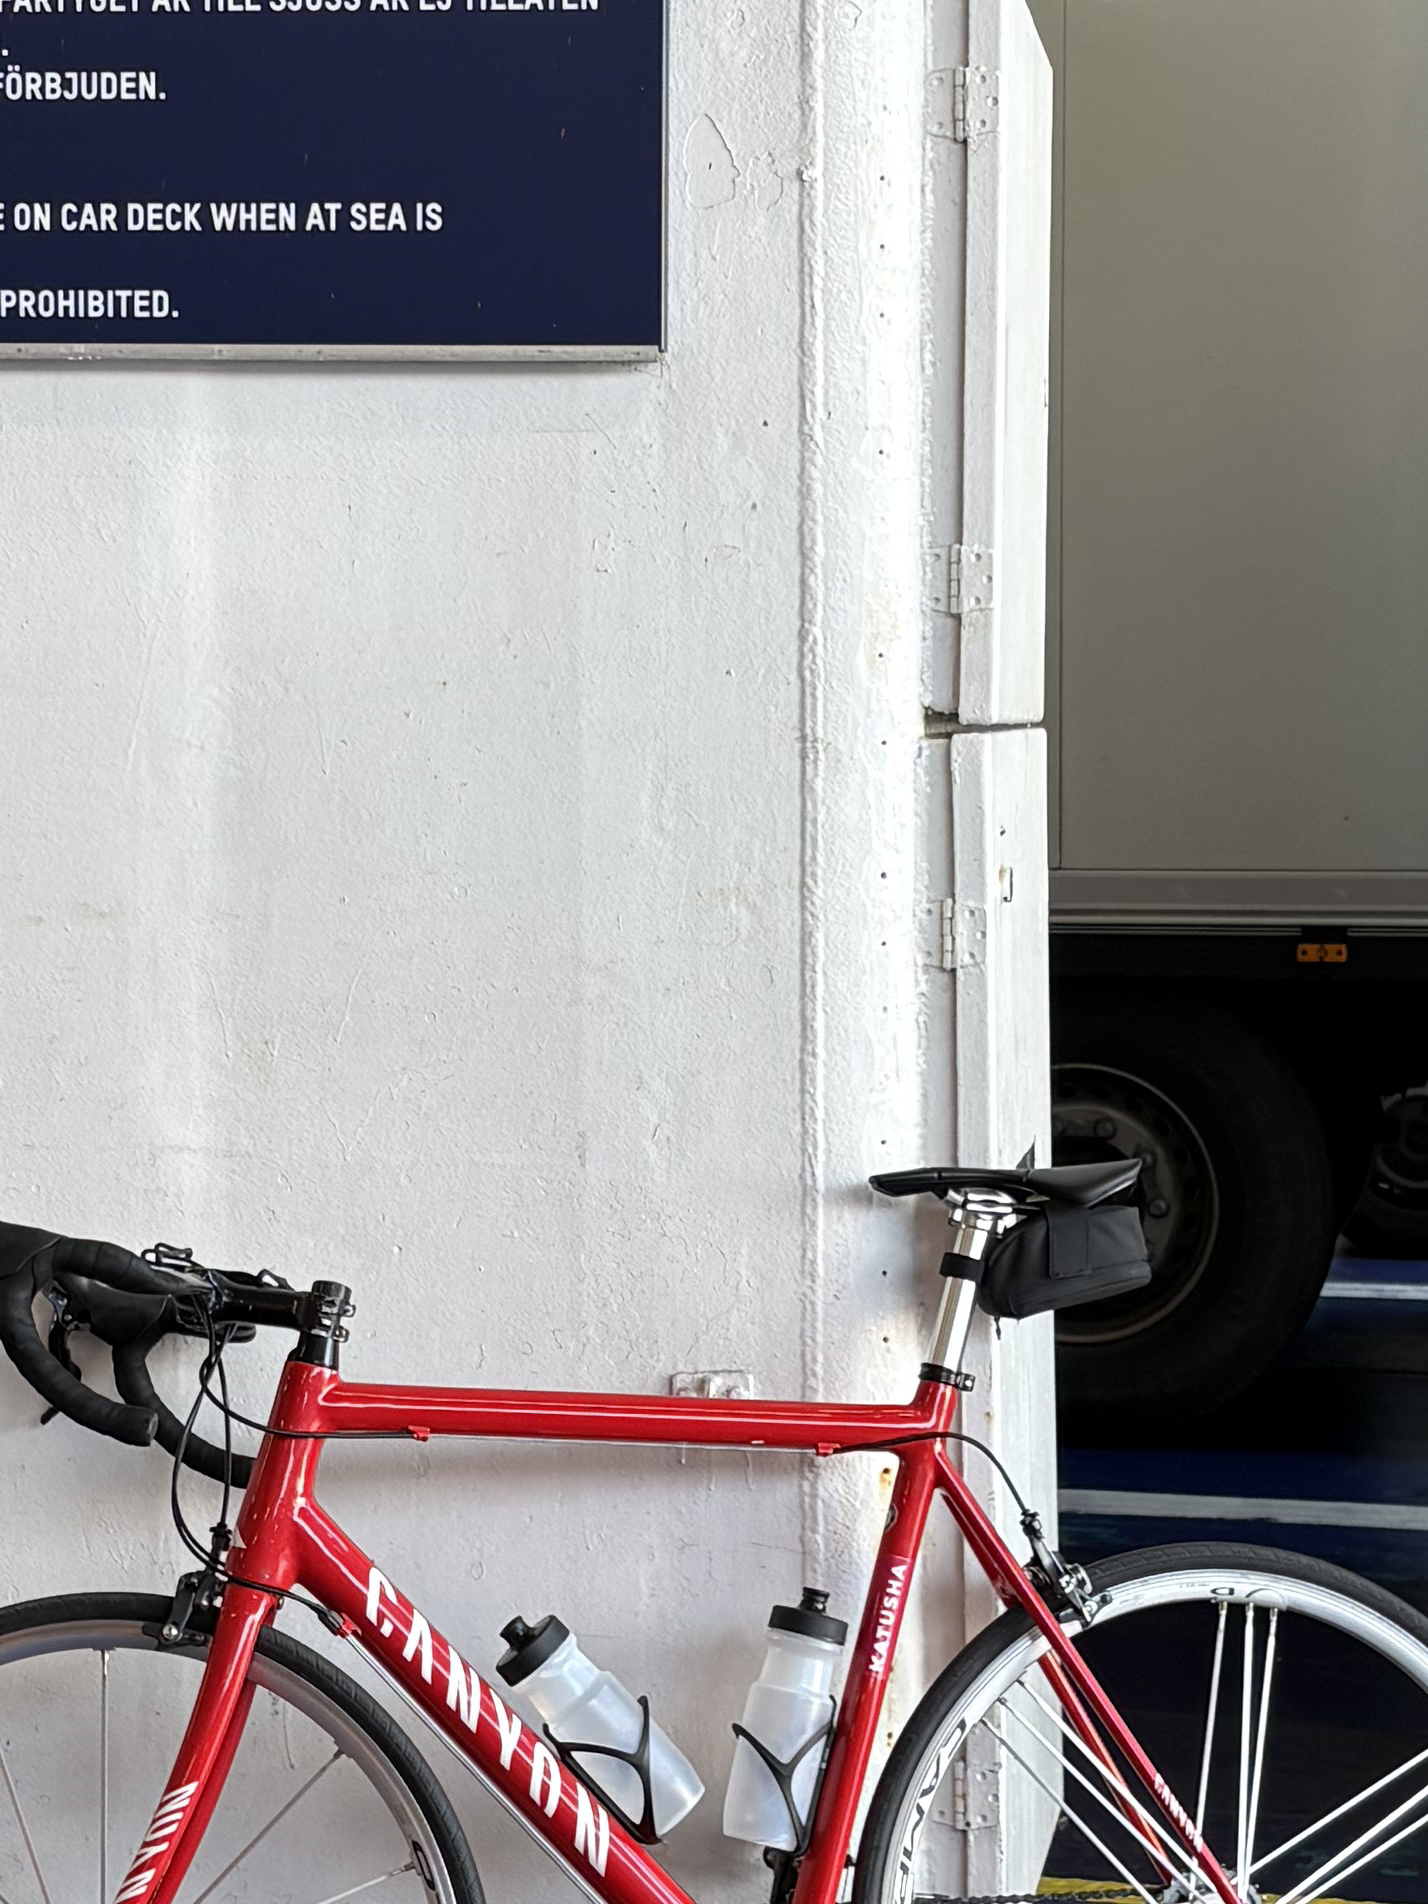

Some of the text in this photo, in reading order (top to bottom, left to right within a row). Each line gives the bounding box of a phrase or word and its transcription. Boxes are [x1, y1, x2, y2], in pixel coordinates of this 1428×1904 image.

[13, 202, 51, 231] ON
[61, 202, 118, 232] CAR
[127, 202, 203, 232] DECK
[209, 202, 296, 232] WHEN
[305, 202, 342, 232] AT
[349, 202, 407, 232] SEA
[416, 202, 443, 231] IS
[0, 289, 179, 318] PROHIBITED.
[868, 1564, 908, 1676] KATUSHA
[366, 1566, 611, 1878] CANYON
